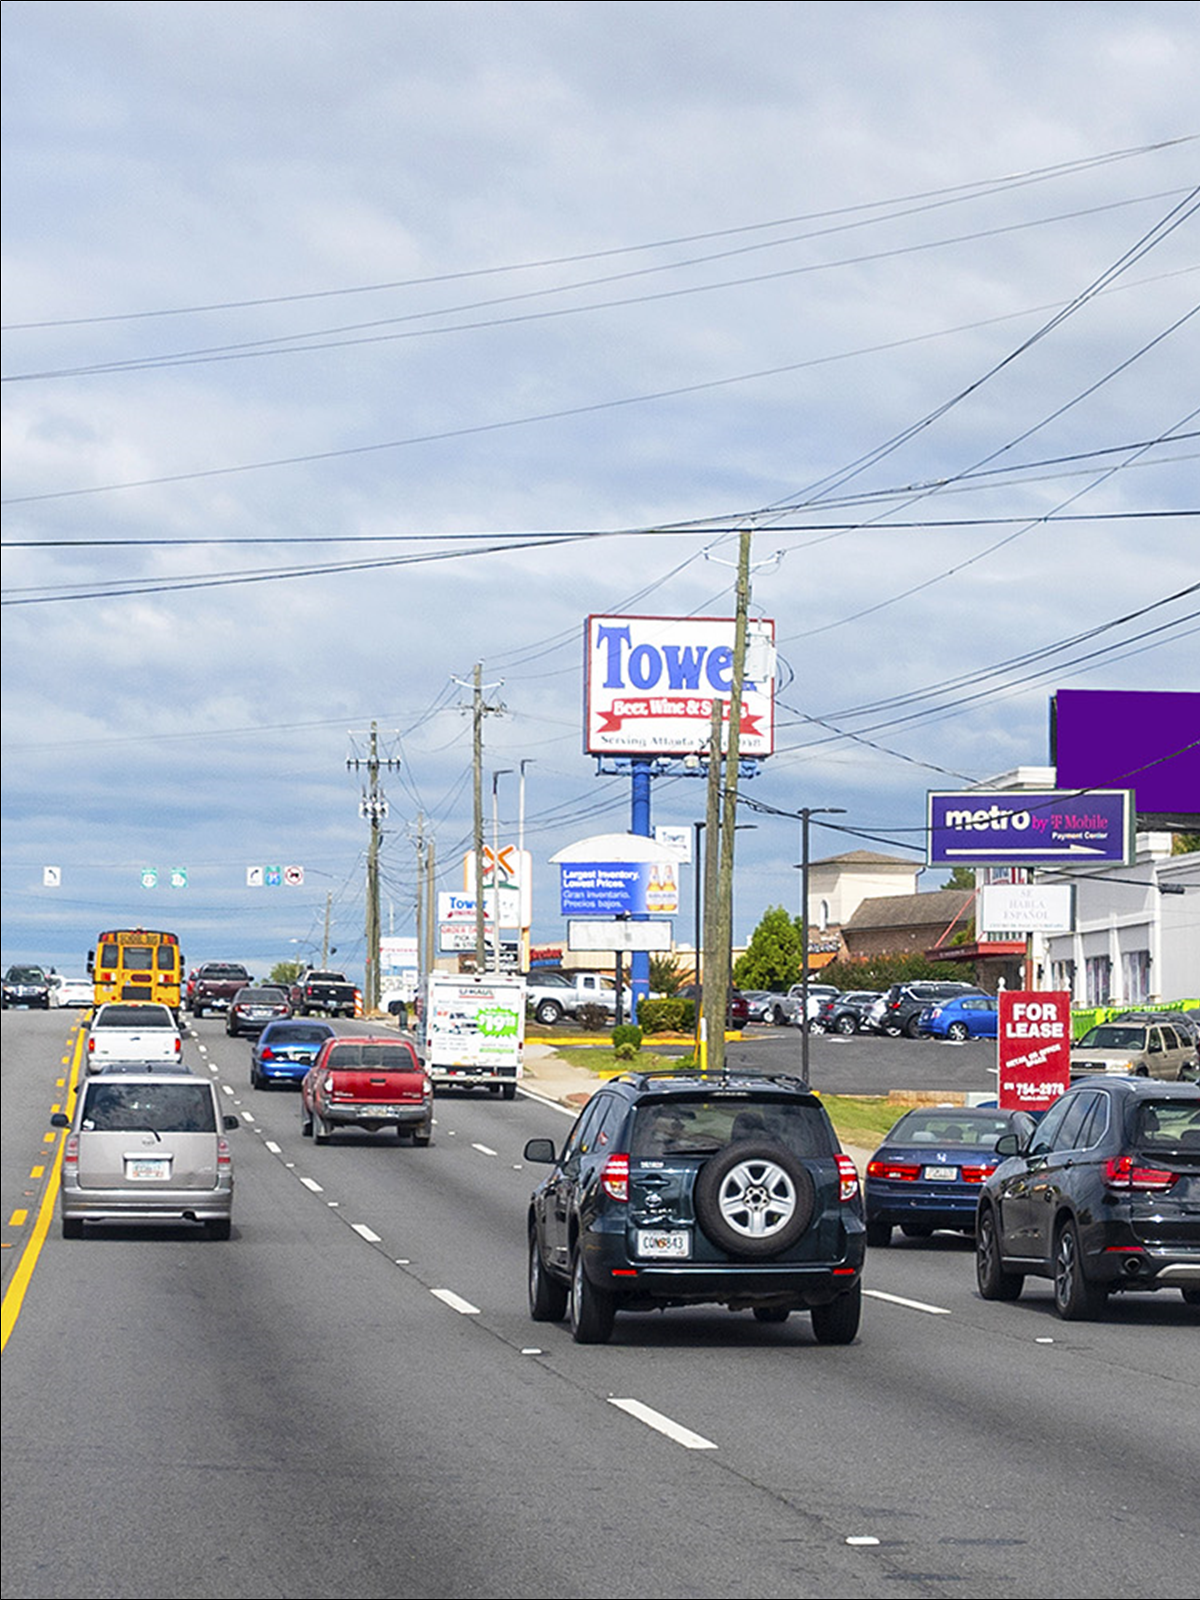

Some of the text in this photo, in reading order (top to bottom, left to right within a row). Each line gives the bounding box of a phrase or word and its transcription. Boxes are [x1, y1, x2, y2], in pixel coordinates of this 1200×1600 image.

[596, 624, 757, 691] Towe
[649, 698, 685, 715] Wine
[945, 805, 1030, 831] metro
[1032, 815, 1049, 833] by
[1052, 831, 1083, 841] Payment
[449, 896, 488, 909] Towr
[1012, 1003, 1058, 1021] FOR
[1006, 1022, 1064, 1038] LEASE
